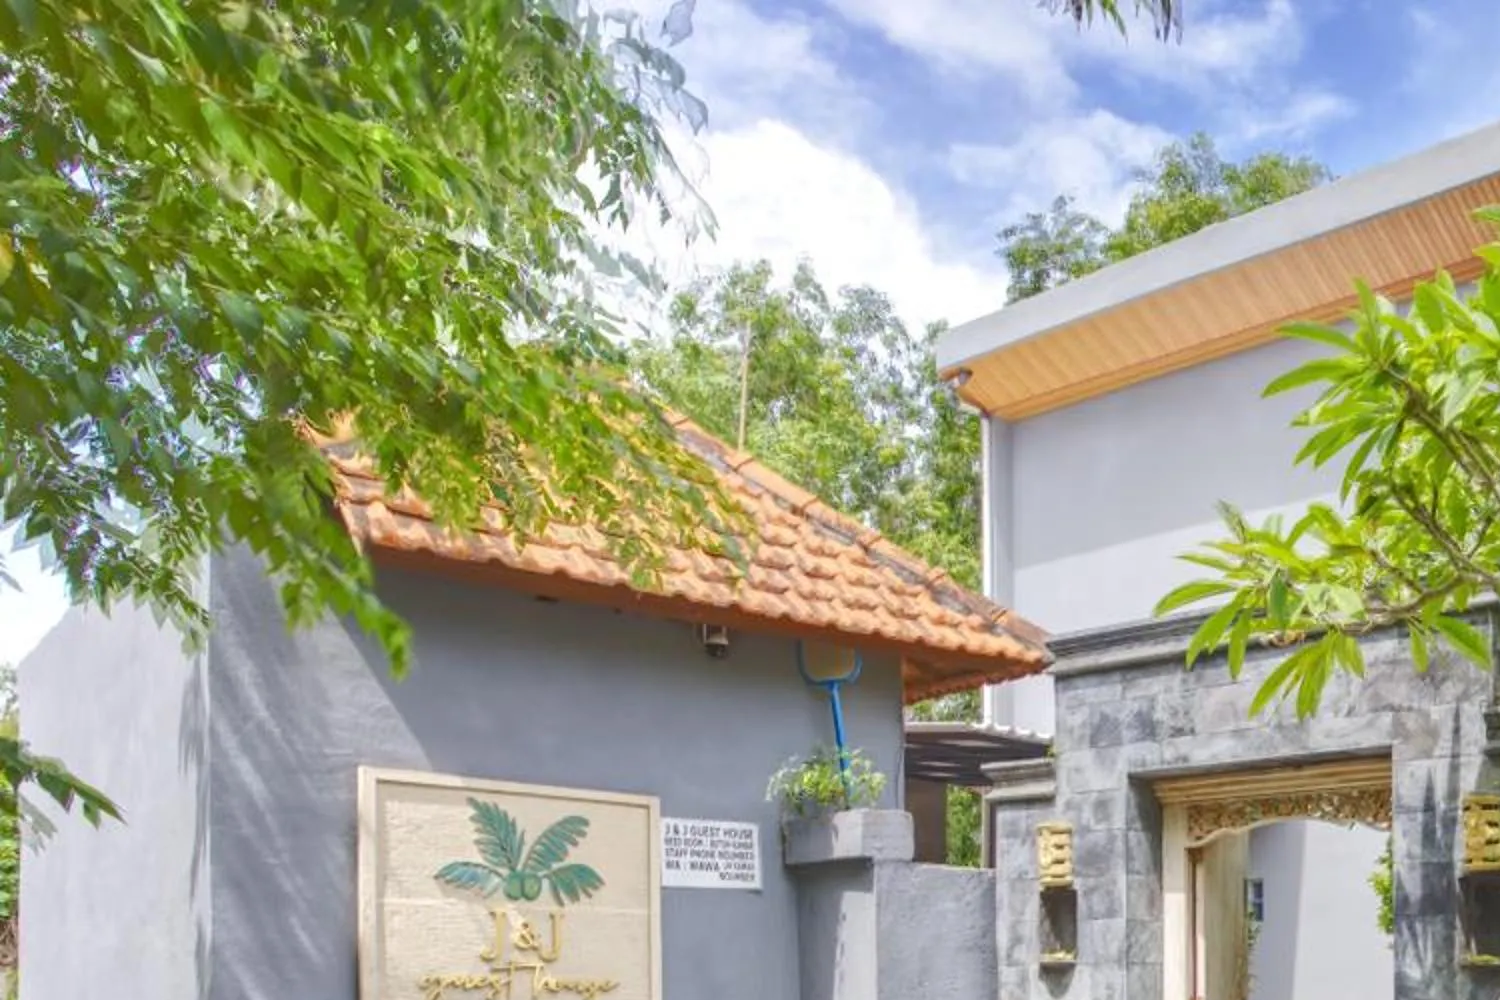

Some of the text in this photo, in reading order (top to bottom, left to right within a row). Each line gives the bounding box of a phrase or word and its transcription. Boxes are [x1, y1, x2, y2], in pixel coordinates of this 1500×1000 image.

[690, 825, 721, 838] GUEST
[723, 828, 753, 840] HOUSE
[664, 847, 688, 858] STAFF
[480, 910, 565, 963] J & J
